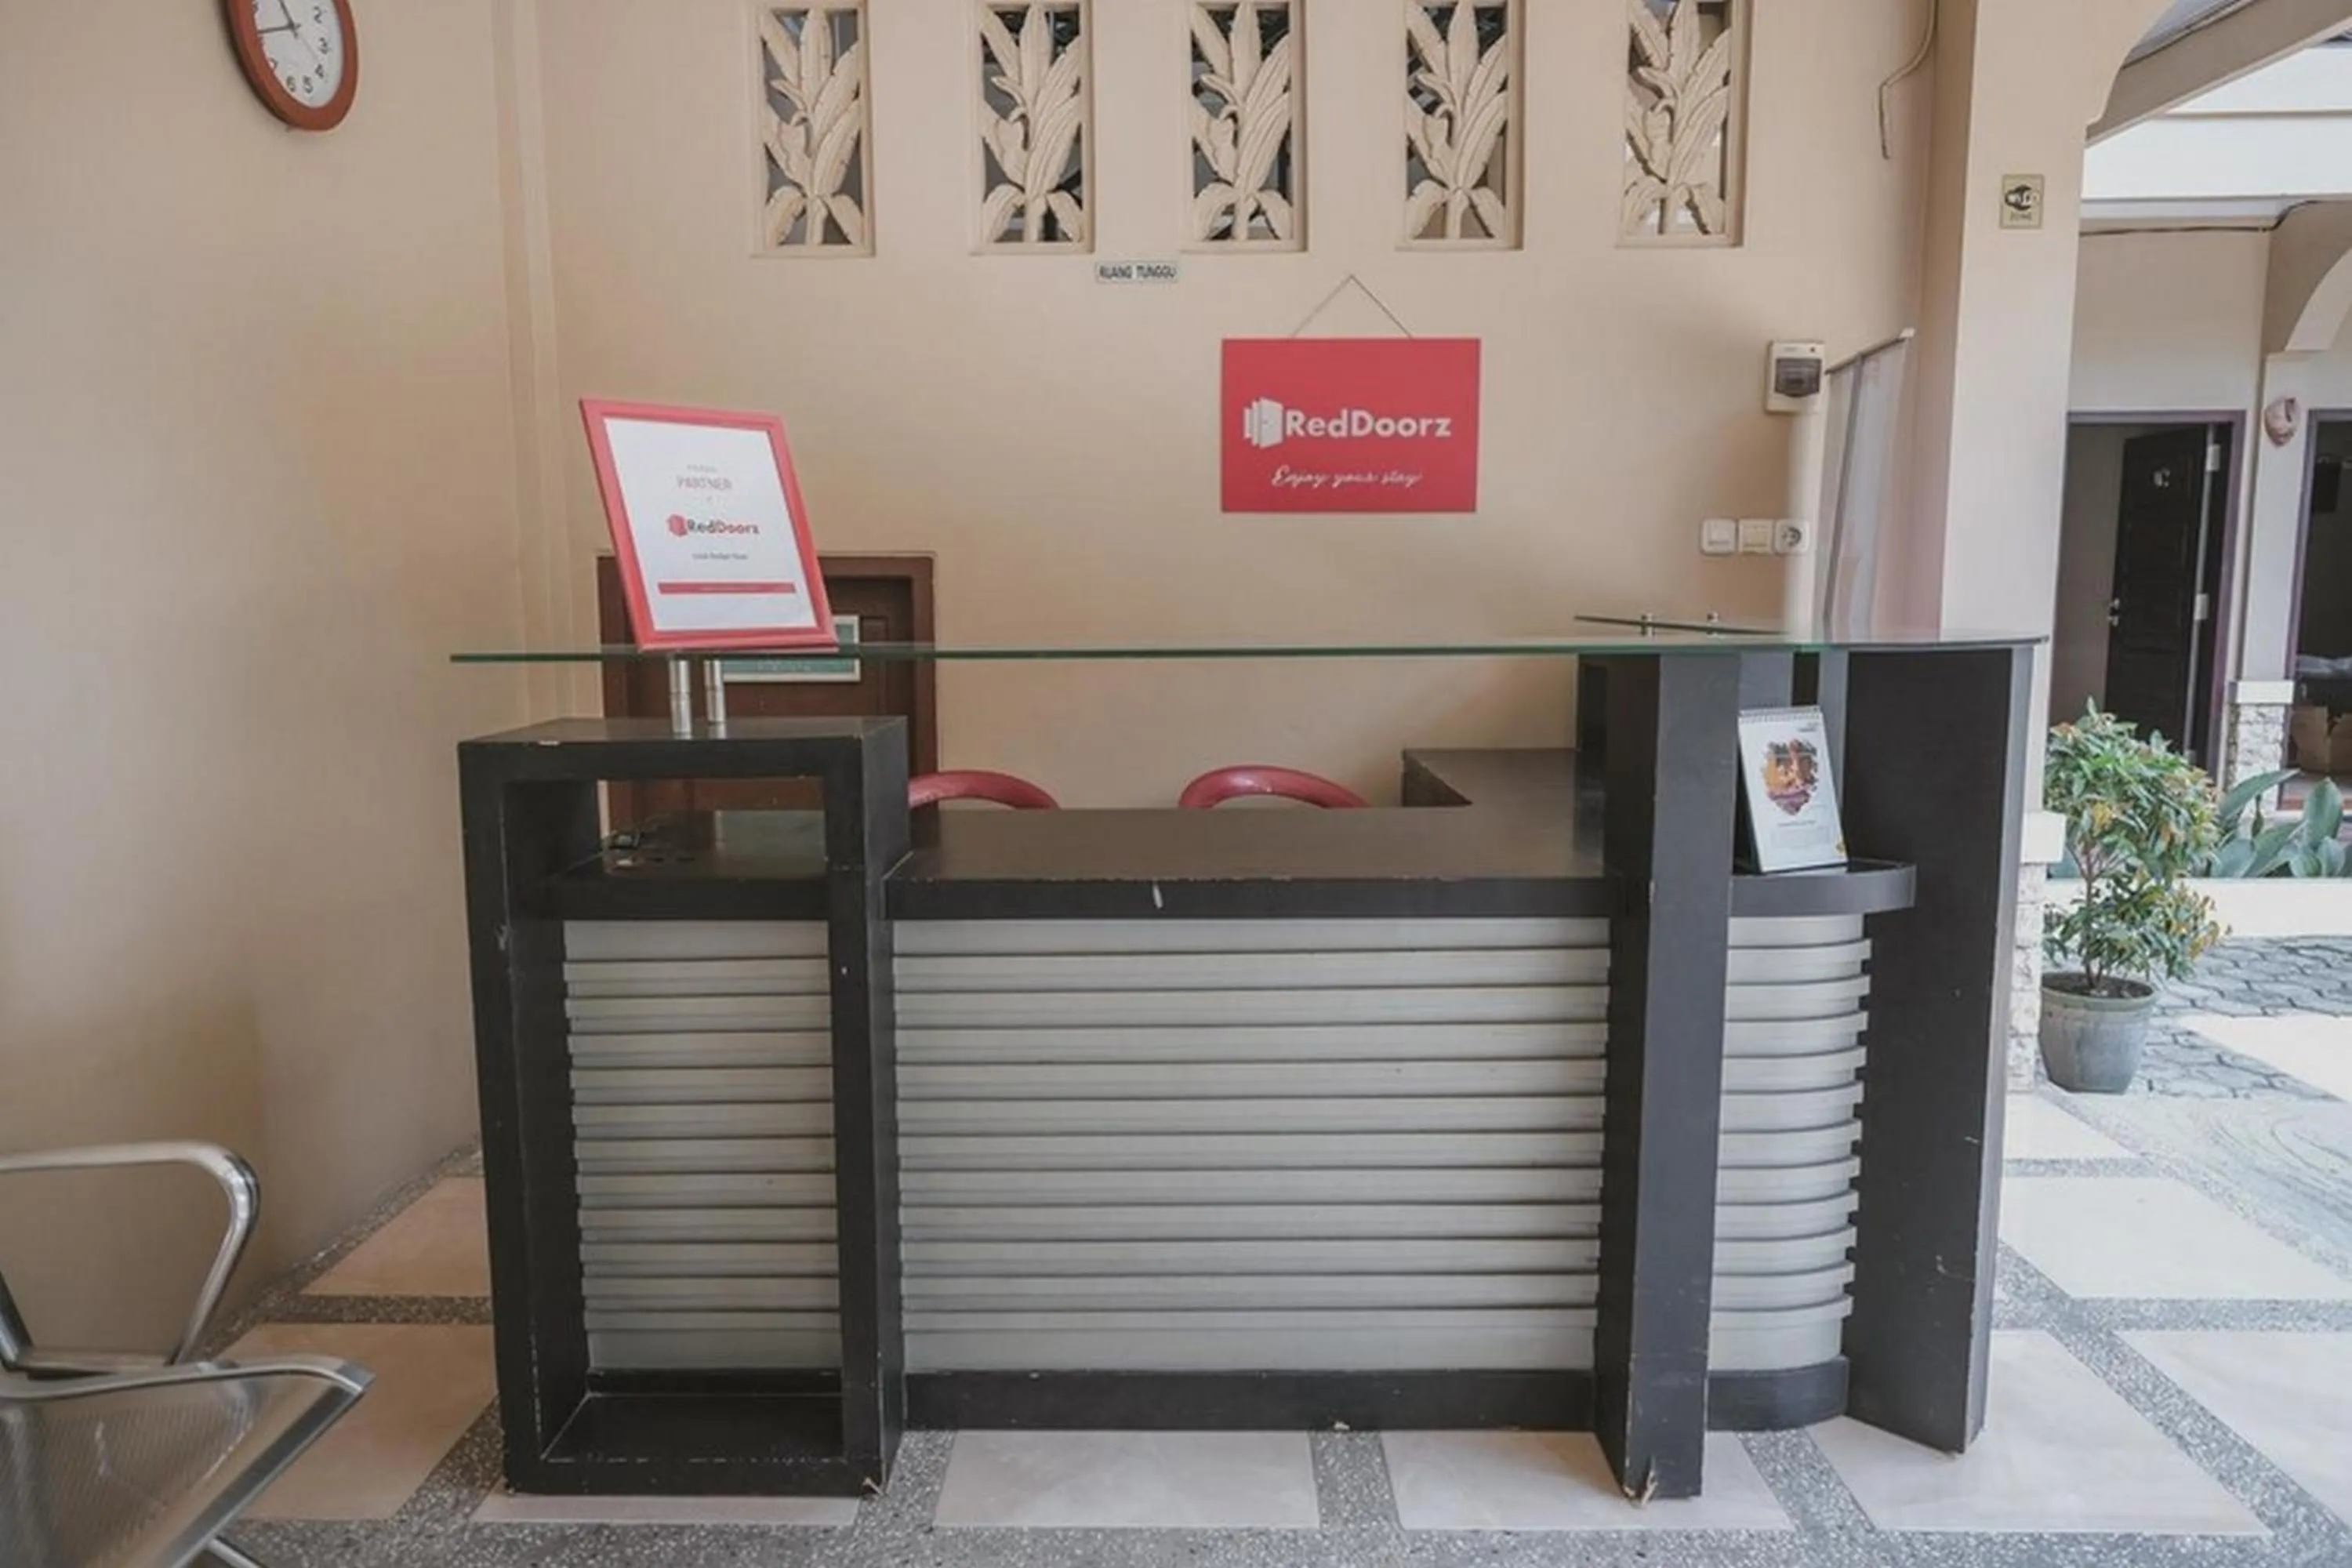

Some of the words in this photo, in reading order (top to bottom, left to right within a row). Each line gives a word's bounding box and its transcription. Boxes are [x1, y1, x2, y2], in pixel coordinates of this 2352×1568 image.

[1099, 265, 1132, 279] RUANG
[1136, 264, 1177, 278] TUNGGU
[1285, 408, 1452, 438] RedDoorz
[1271, 464, 1327, 488] Enjoy
[1331, 472, 1378, 488] your
[1381, 470, 1422, 488] stay
